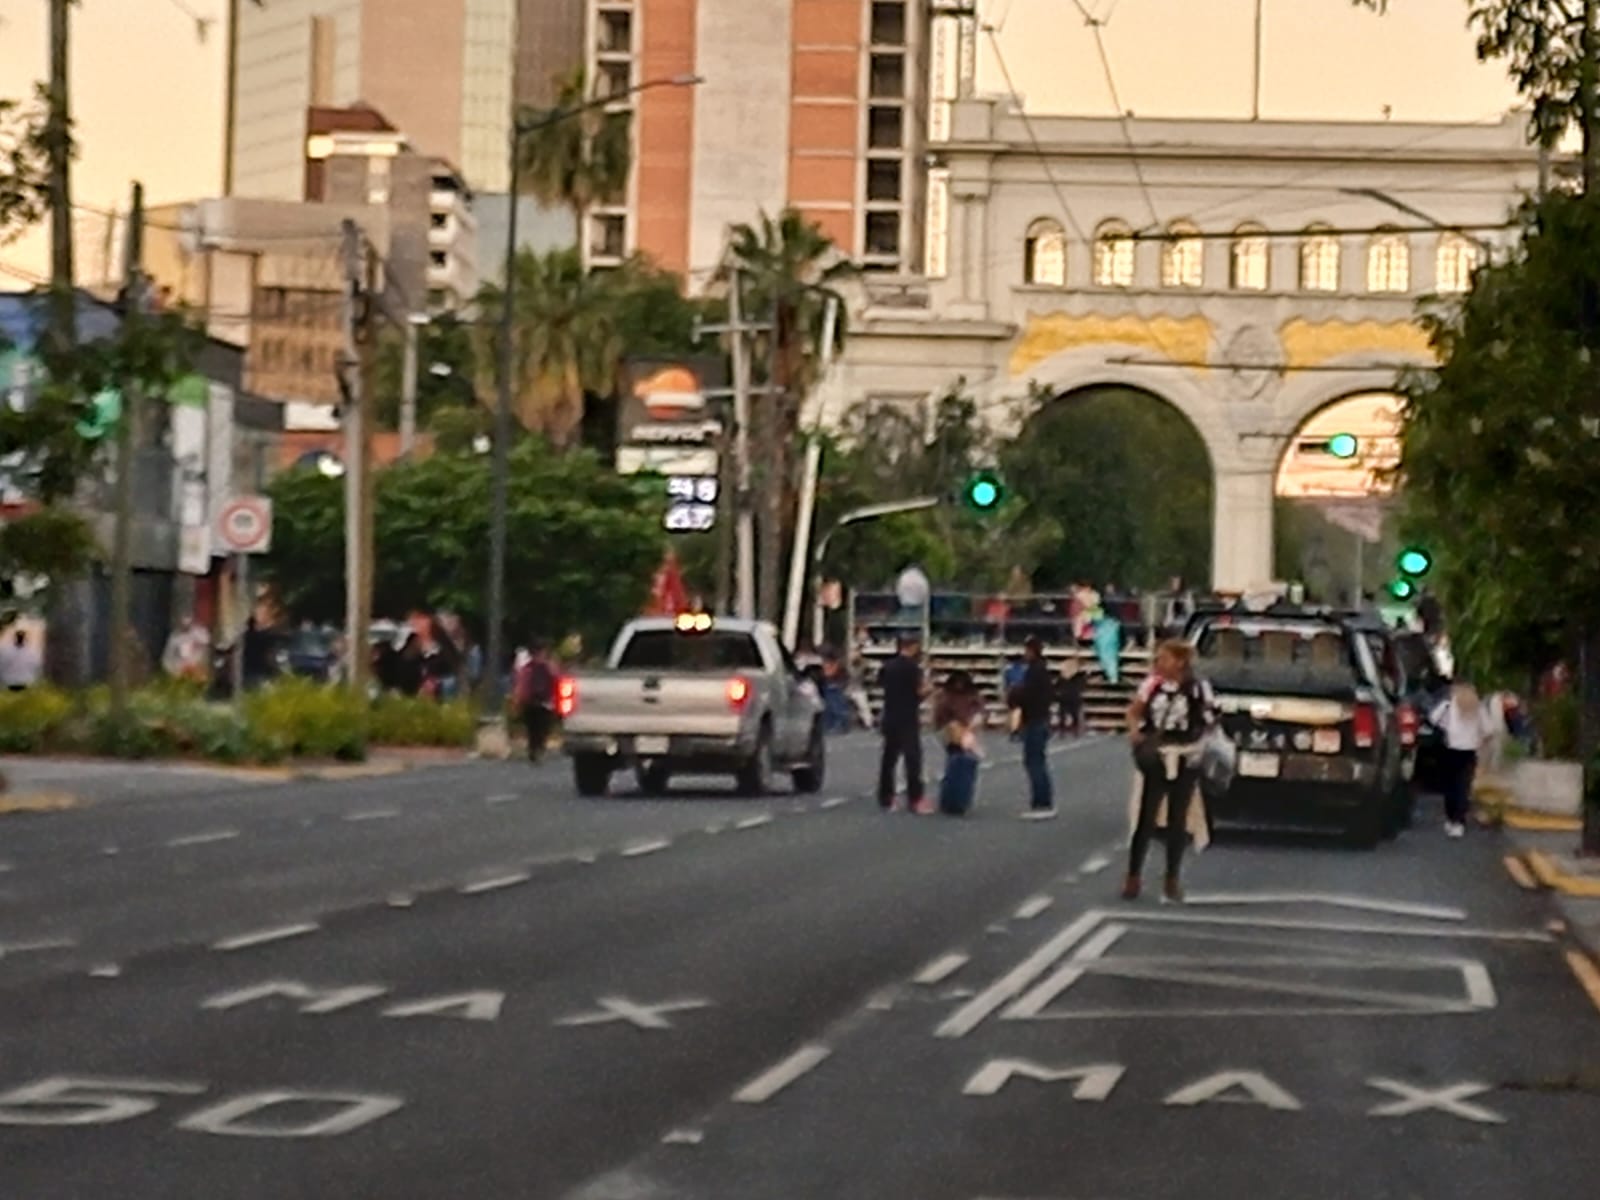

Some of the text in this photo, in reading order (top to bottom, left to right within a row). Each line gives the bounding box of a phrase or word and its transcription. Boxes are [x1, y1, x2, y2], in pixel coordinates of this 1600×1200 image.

[202, 981, 708, 1028] MAX
[0, 1076, 404, 1137] 50
[962, 1060, 1507, 1123] MAX
